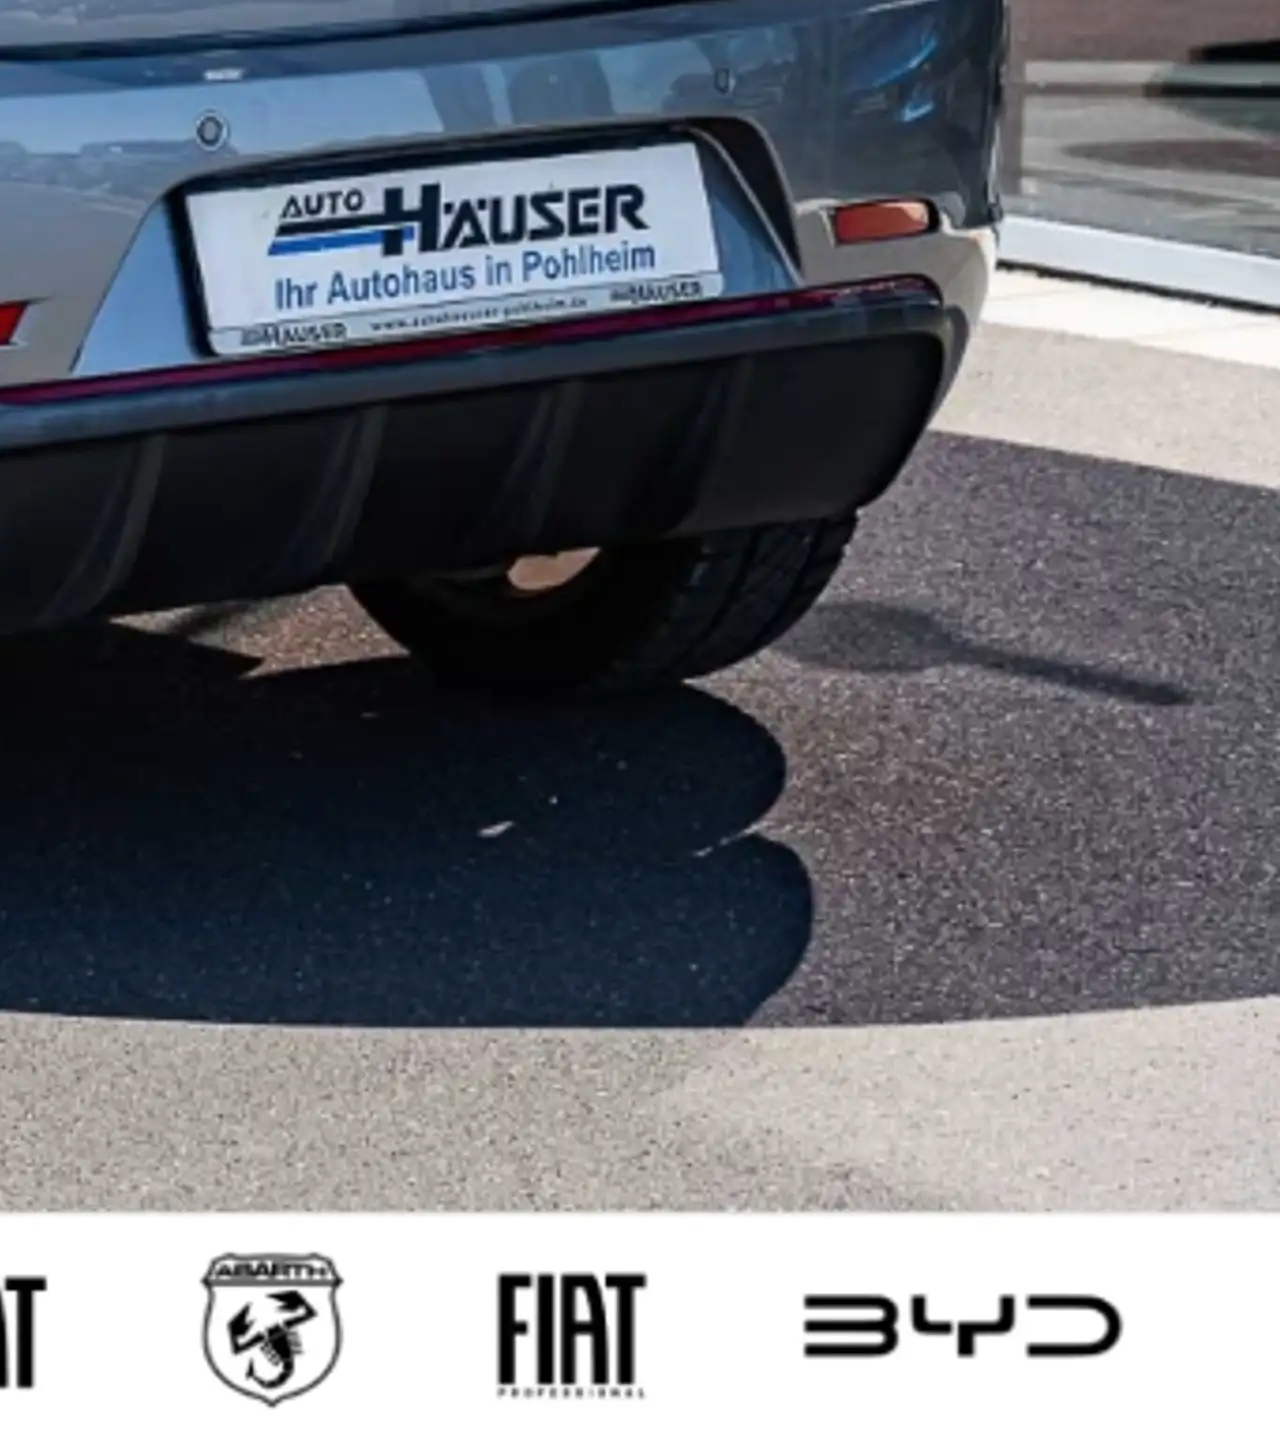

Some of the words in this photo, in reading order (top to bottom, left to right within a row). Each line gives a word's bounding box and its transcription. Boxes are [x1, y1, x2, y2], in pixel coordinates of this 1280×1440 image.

[281, 188, 364, 218] AUTO
[381, 181, 650, 256] HÄUSER
[274, 277, 318, 310] Ihr
[326, 263, 476, 305] Autohaus
[485, 254, 513, 286] in
[521, 240, 655, 283] Pohlheim
